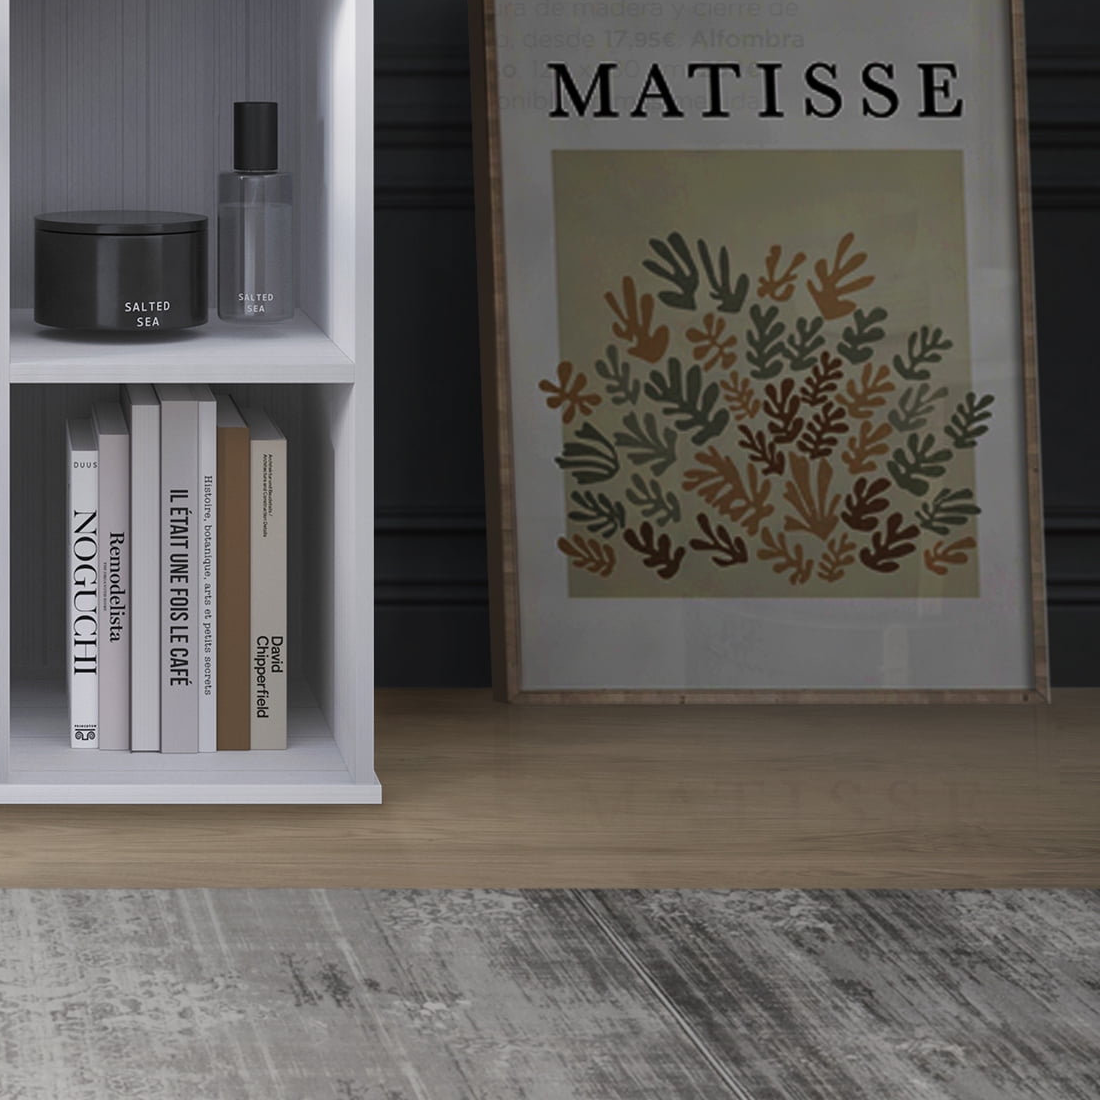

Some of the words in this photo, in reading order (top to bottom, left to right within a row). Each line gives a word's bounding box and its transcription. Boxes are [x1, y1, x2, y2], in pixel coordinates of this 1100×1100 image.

[523, 29, 595, 48] desde
[690, 27, 805, 48] Alfombra
[547, 62, 964, 118] MATISSE
[124, 301, 170, 312] SALTED
[238, 293, 274, 302] SALTED
[247, 304, 266, 312] SEA
[136, 317, 160, 327] SEA
[170, 488, 188, 503] IL
[202, 475, 212, 521] Histoire,
[170, 507, 192, 549] ÉTAIT
[170, 552, 188, 584] UNE
[202, 524, 212, 580] botanique,
[73, 510, 98, 676] NOGUCHI
[109, 531, 126, 643] Remodelista
[170, 588, 188, 622] FOIS
[204, 608, 212, 620] et
[170, 626, 188, 643] LE
[202, 622, 212, 653] petits
[170, 648, 193, 686] CAFÉ
[271, 636, 284, 674] David
[254, 635, 269, 718] Chipperfield
